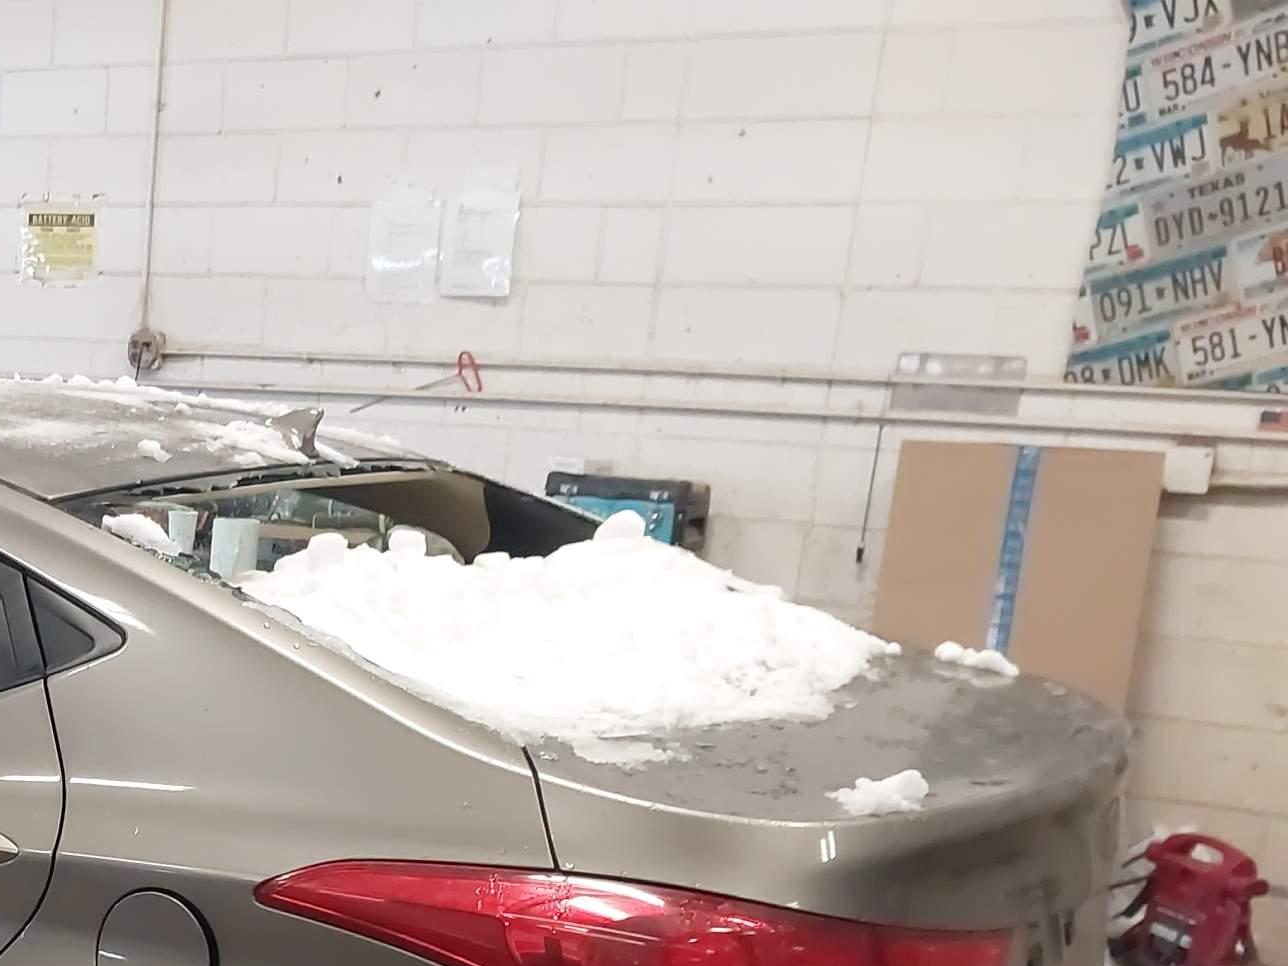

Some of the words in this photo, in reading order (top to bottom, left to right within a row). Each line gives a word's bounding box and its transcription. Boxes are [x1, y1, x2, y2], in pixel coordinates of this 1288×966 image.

[1150, 127, 1206, 173] VWJ
[1187, 173, 1245, 199] TEXAS
[32, 214, 68, 226] BATTERY
[71, 214, 91, 226] ACID
